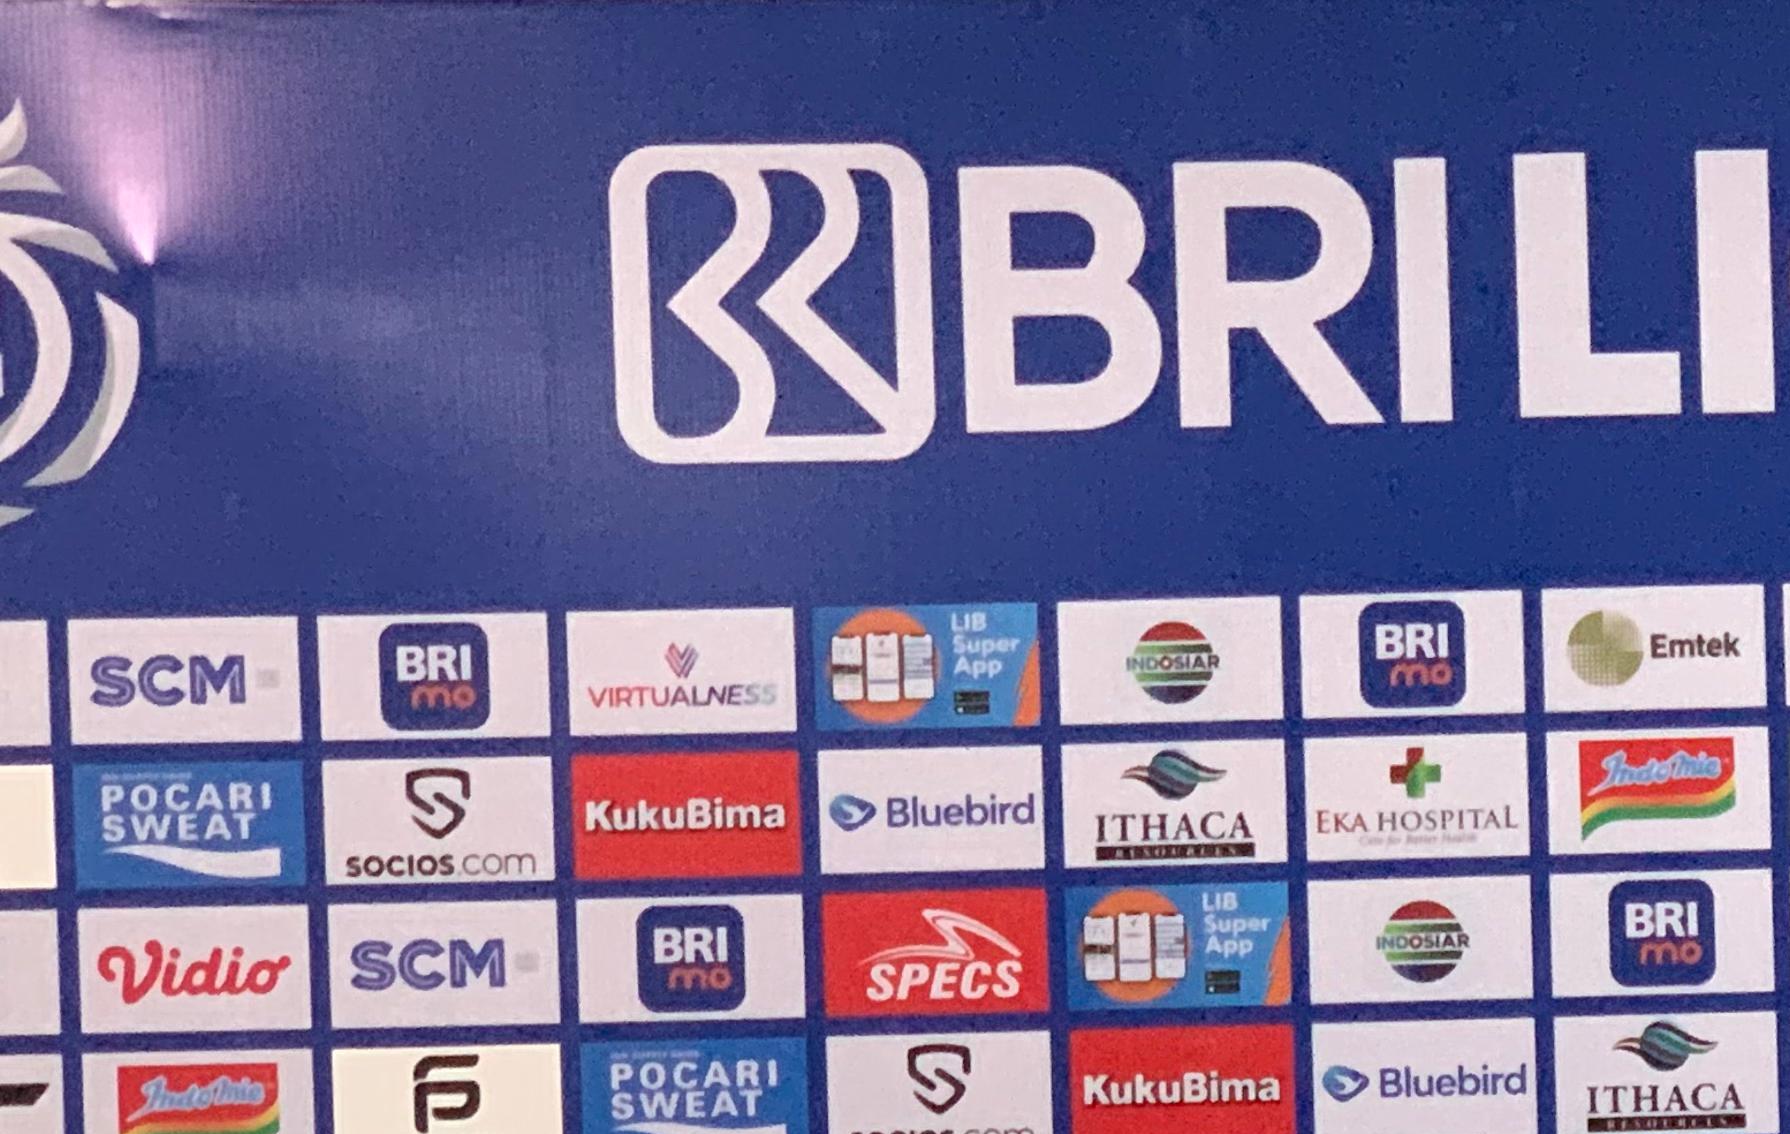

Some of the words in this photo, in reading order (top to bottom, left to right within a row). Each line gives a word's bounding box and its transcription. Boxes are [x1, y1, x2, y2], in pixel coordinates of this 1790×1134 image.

[956, 157, 1456, 434] BRI
[950, 612, 986, 632] LIB
[952, 636, 1020, 658] Super
[1373, 622, 1448, 659] BRI
[1649, 631, 1740, 658] Emtek
[395, 644, 471, 681] BRI
[954, 656, 1002, 676] App
[1125, 653, 1219, 672] INDOSIAR
[90, 654, 246, 707] SCM
[587, 684, 777, 708] VIRTUALNESS
[101, 781, 272, 812] POCARI
[886, 792, 1034, 829] Bluebird
[102, 812, 257, 843] SWEAT
[584, 796, 785, 832] KukuBima
[1094, 811, 1256, 843] ITHACA
[1315, 809, 1366, 834] EKA
[1376, 804, 1518, 831] HOSPITAL
[1201, 892, 1236, 911] LIB
[1203, 915, 1270, 938] Super
[1623, 902, 1698, 938] BRI
[652, 927, 728, 964] BRI
[1205, 935, 1252, 956] App
[97, 939, 290, 1004] Vidio
[350, 938, 505, 991] SCM
[865, 960, 1022, 1002] SPECS
[609, 1058, 778, 1089] POCARI
[1081, 1070, 1280, 1106] KukuBima
[1379, 1062, 1526, 1099] Bluebird
[610, 1089, 763, 1120] SWEAT
[1586, 1082, 1746, 1114] ITHACA
